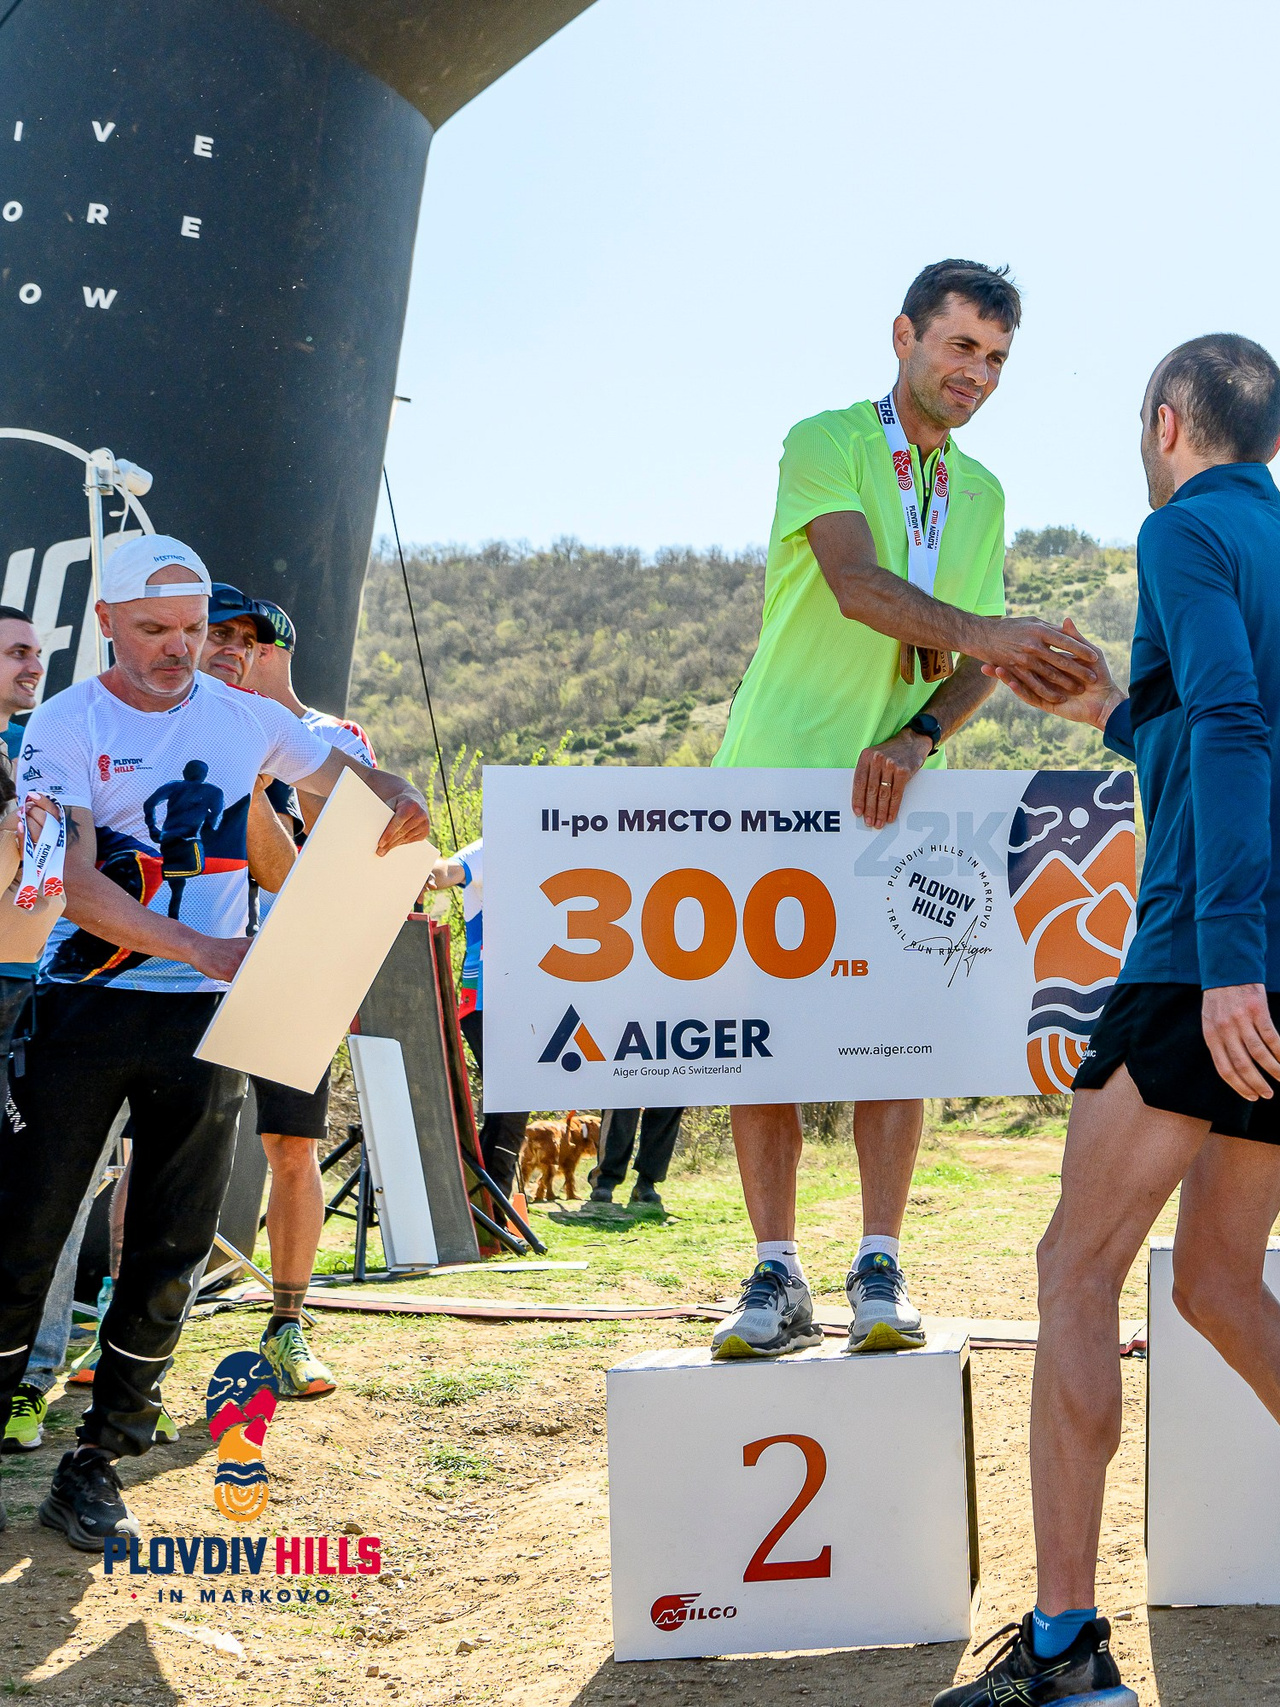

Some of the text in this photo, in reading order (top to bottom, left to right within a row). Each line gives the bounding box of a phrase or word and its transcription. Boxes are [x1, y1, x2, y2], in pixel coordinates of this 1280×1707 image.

[909, 504, 922, 547] PLOVDIV HILLS
[928, 525, 937, 550] PLOVDIV
[114, 765, 135, 773] HILLS
[617, 809, 732, 832] МЯСТО
[741, 810, 841, 833] МЪЖЕ
[853, 811, 1008, 877] 22K
[887, 844, 993, 929] PLOVDIV HILLS IN MARKOVO
[908, 871, 977, 913] PLOVDIV
[537, 867, 838, 982] 300
[887, 908, 907, 941] TRAIL
[910, 940, 932, 954] RUN
[911, 896, 957, 928] HILLS
[613, 1019, 774, 1061] AIGER
[838, 1043, 933, 1059] www.aiger.com
[613, 1064, 742, 1079] Aiger Group AG Switzerland
[742, 1433, 832, 1583] 2
[654, 1605, 738, 1625] MILCO
